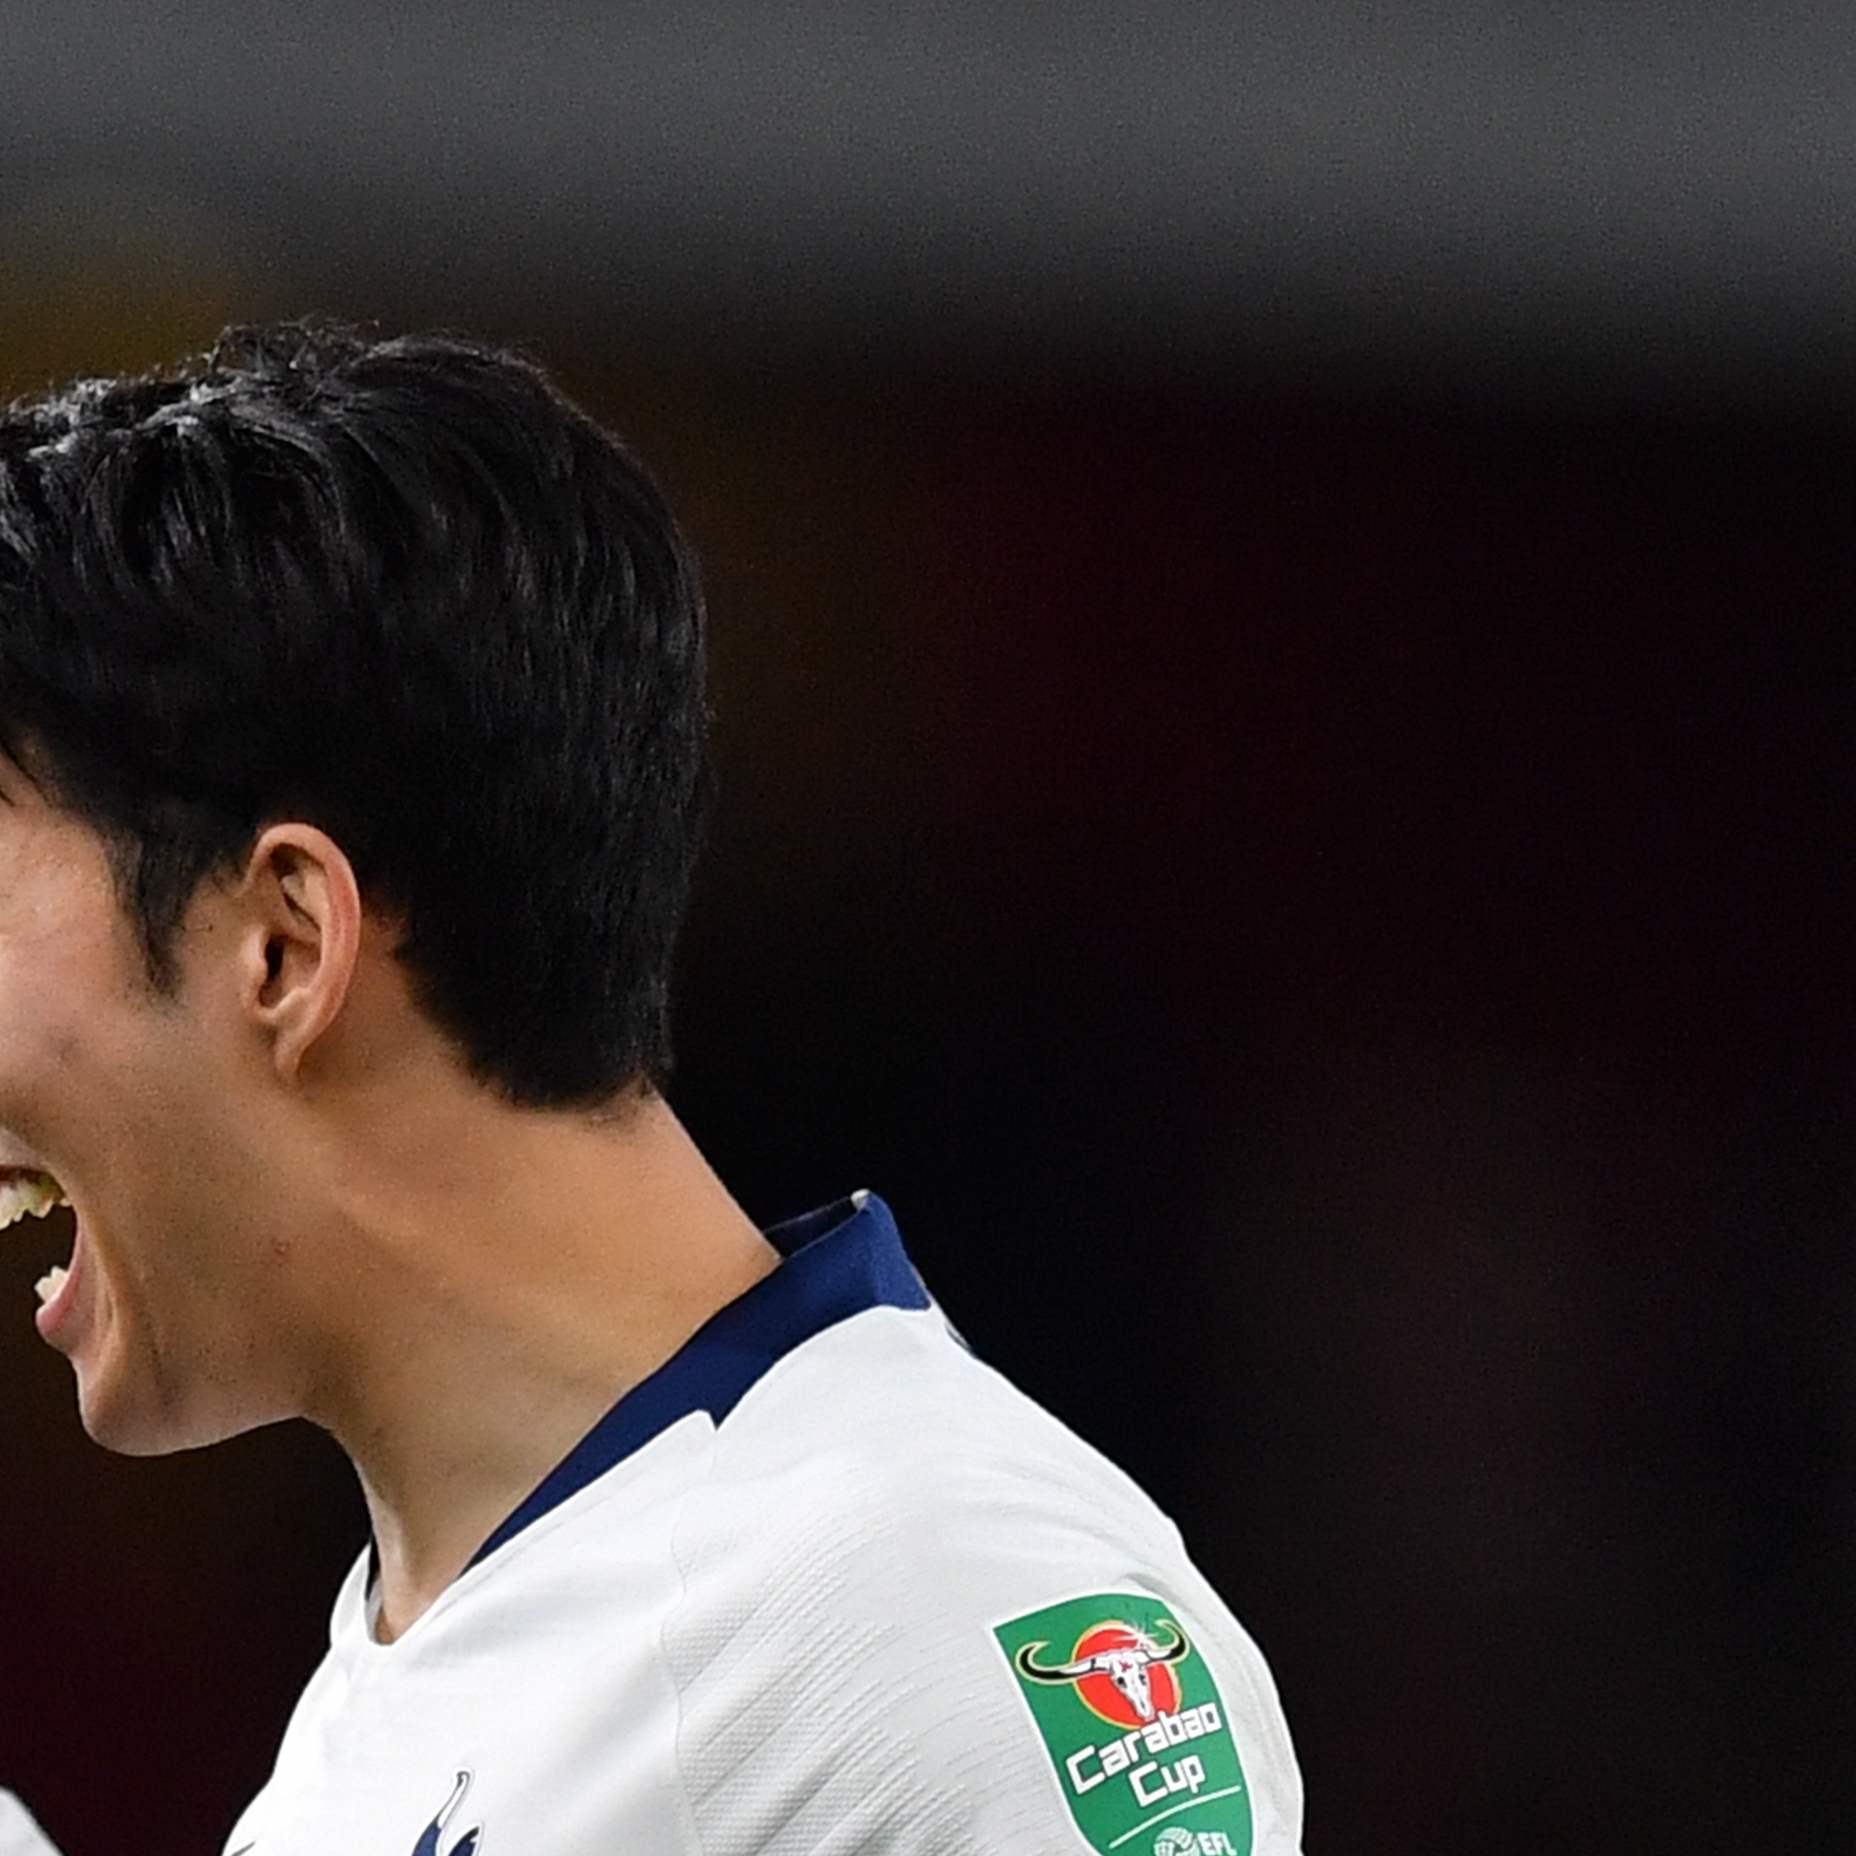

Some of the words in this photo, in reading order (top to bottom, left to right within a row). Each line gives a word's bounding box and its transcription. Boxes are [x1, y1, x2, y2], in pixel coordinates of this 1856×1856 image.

[1065, 1702, 1222, 1794] Carabao
[1128, 1755, 1206, 1807] Cup
[1199, 1831, 1237, 1856] EFL
